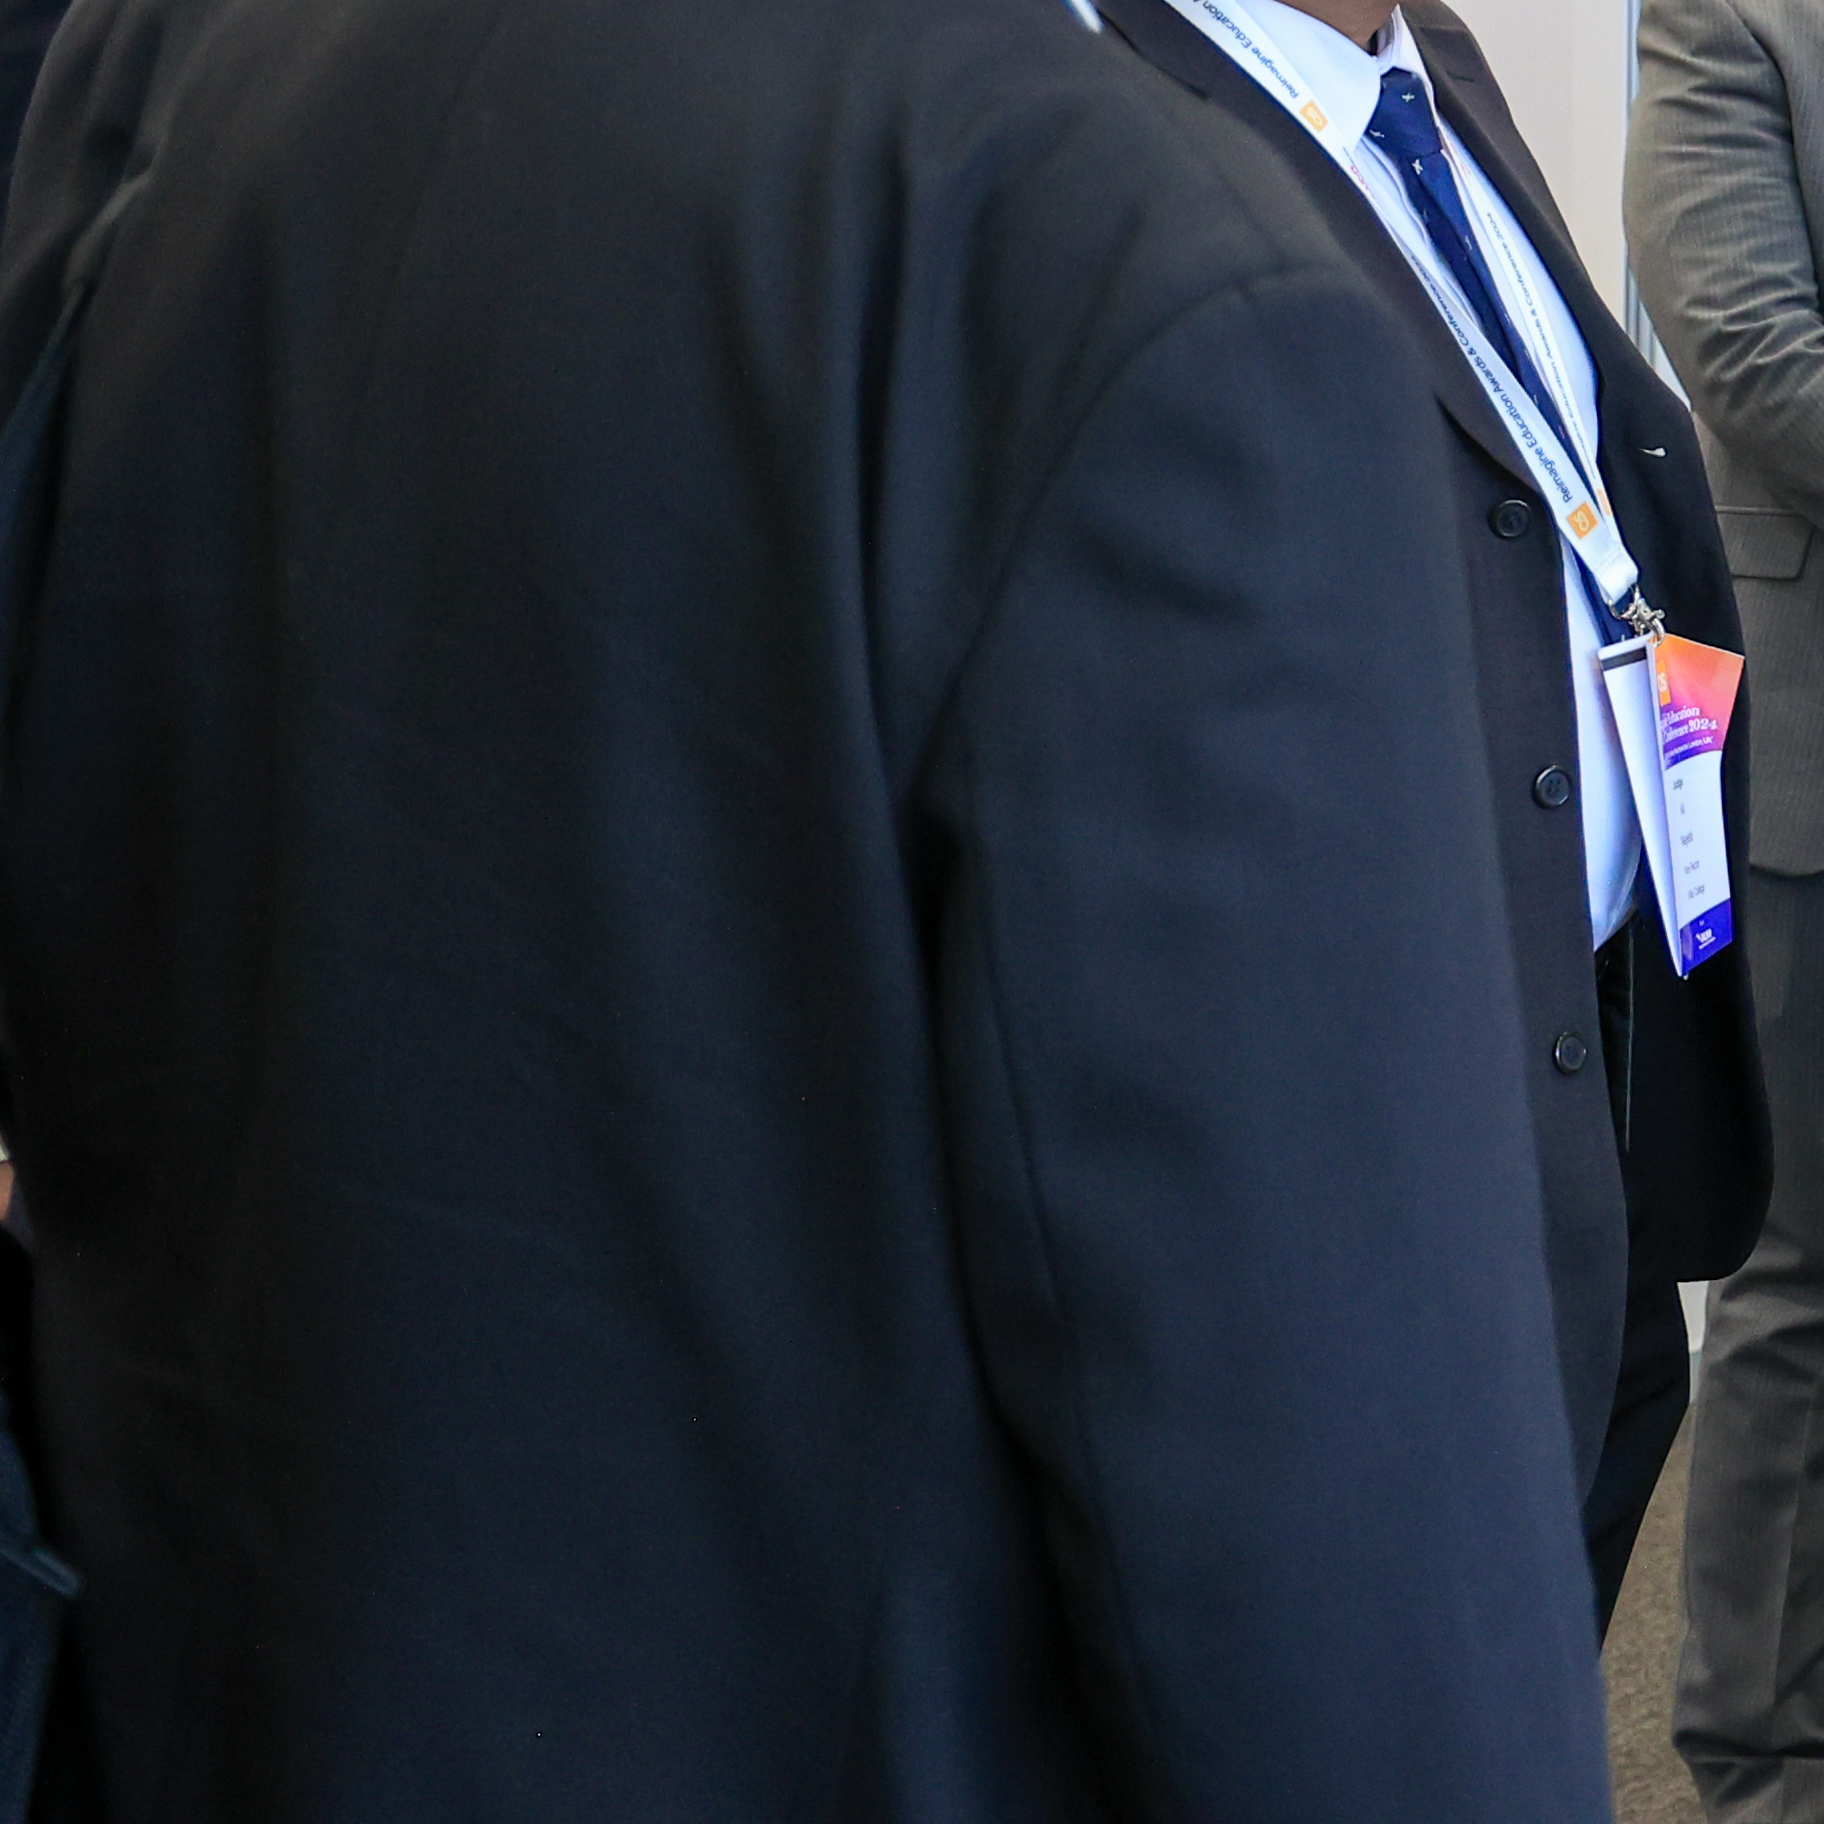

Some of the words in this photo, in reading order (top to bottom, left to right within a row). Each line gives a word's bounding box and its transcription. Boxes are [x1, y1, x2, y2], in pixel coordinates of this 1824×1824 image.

[1247, 45, 1302, 99] Reimagine
[1486, 210, 1504, 241] 2024
[1500, 241, 1533, 307] Conference
[1424, 283, 1471, 347] Conference
[1528, 308, 1536, 317] &
[1466, 347, 1476, 356] &
[1532, 318, 1554, 359] Awards
[1472, 354, 1503, 395] Awards
[1547, 361, 1576, 418] Education
[1497, 392, 1538, 448] Education
[1531, 444, 1575, 503] Reimagine
[1573, 510, 1591, 531] QS
